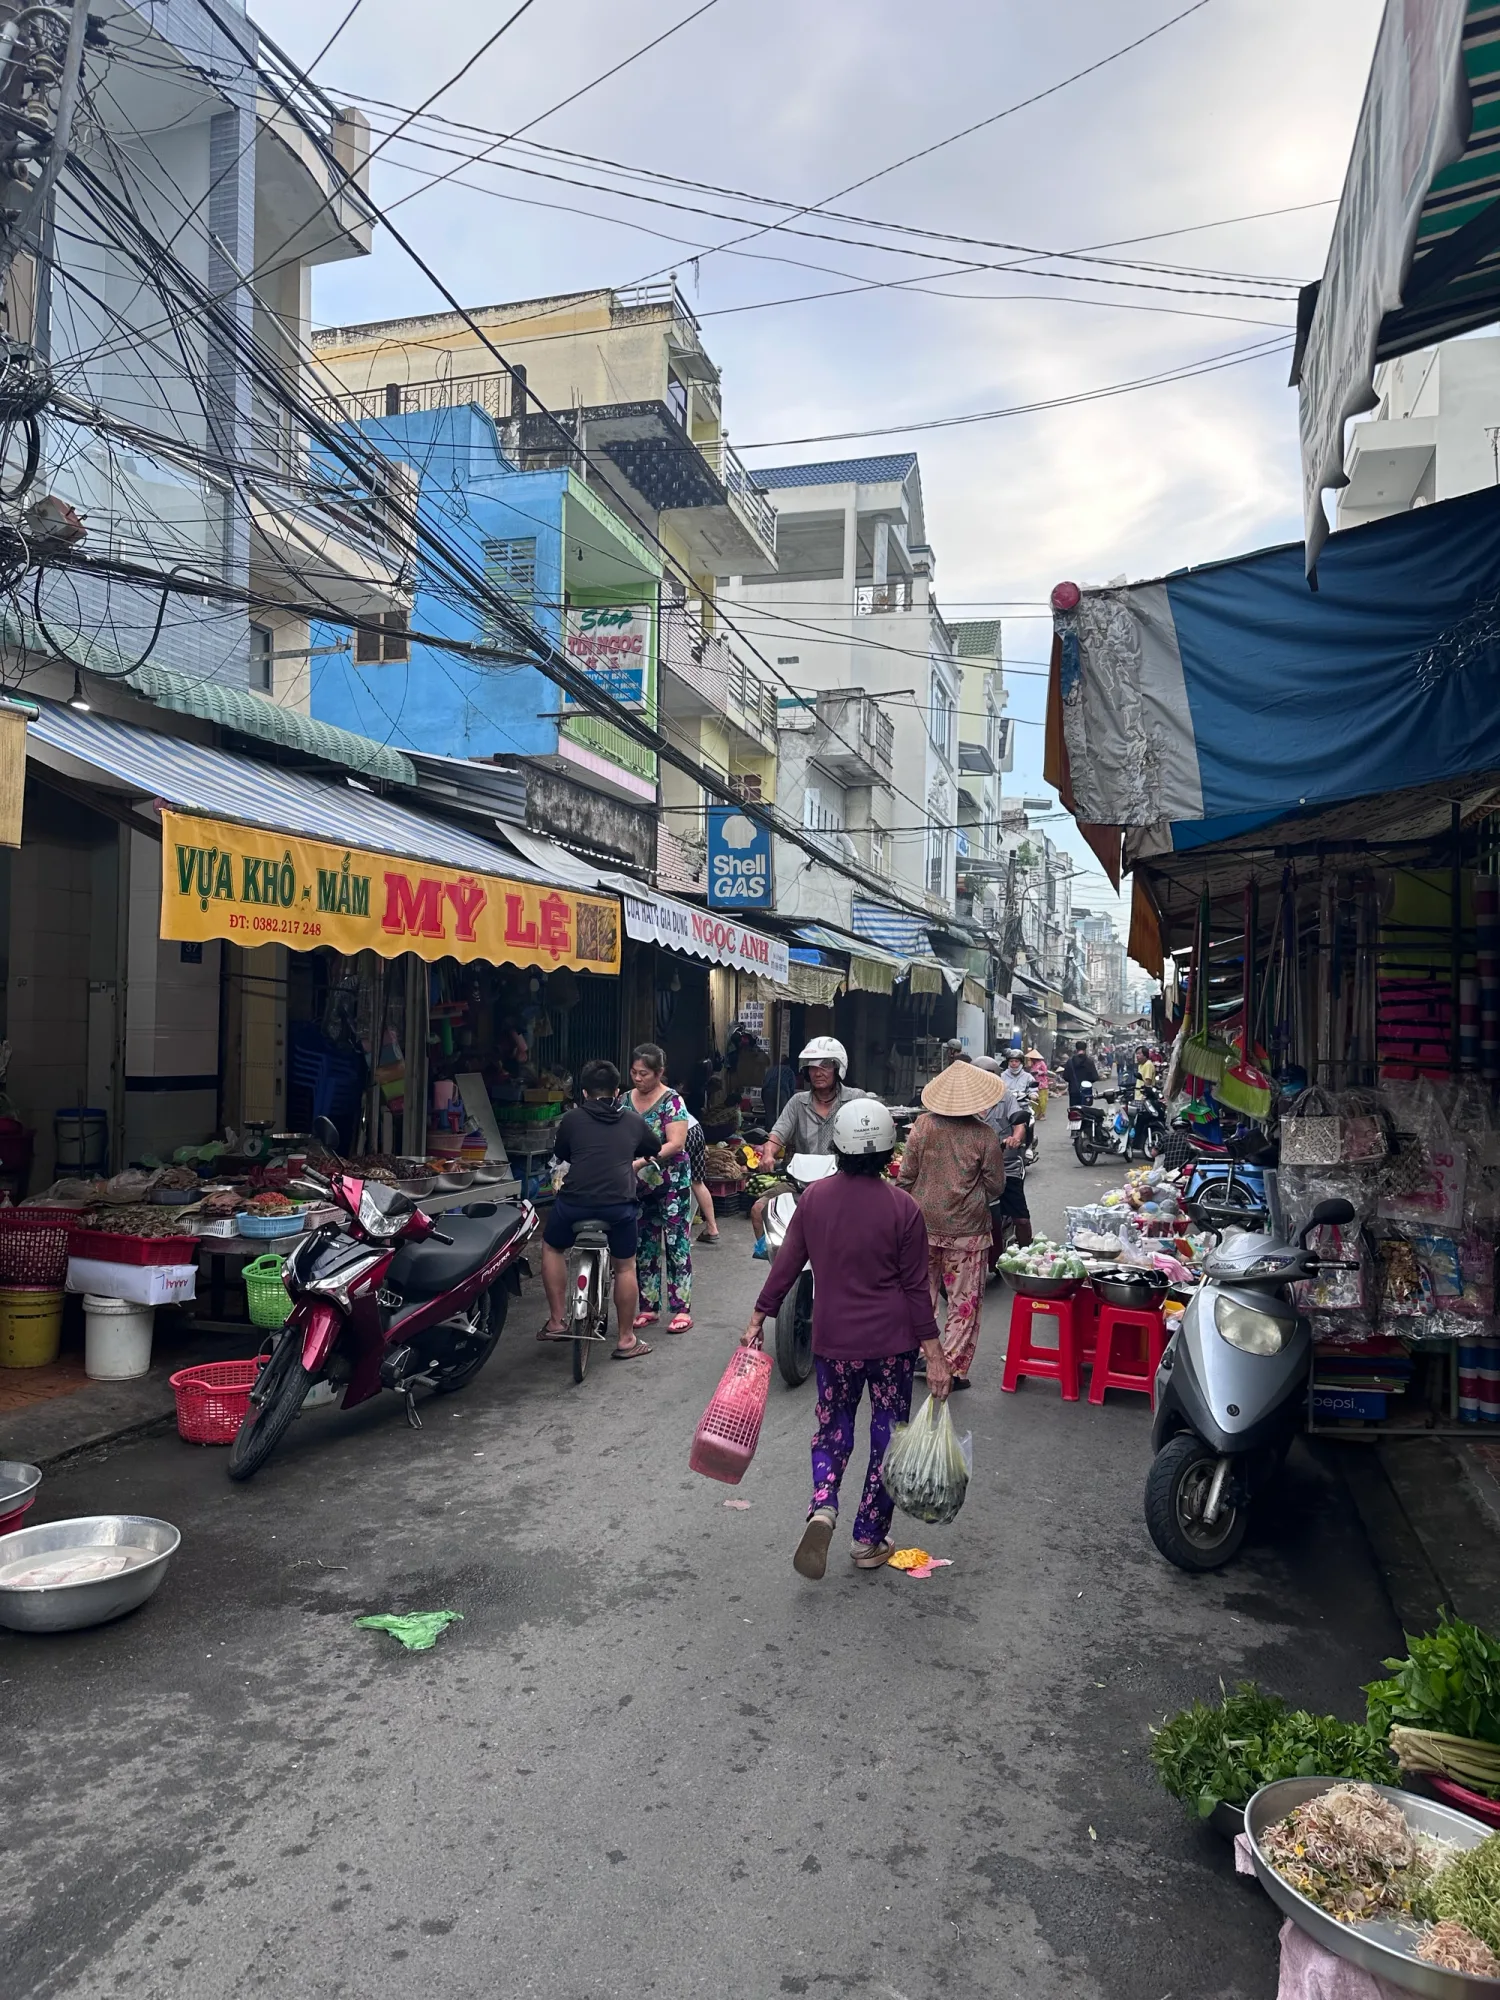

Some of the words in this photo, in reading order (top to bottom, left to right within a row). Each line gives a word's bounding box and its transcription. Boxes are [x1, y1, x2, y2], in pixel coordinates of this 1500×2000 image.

[580, 609, 634, 631] Shop
[597, 634, 643, 659] NGỌC
[713, 854, 766, 876] Shell
[175, 844, 235, 913] VỰA
[240, 850, 296, 909] KHÔ
[316, 851, 372, 918] MẮM
[714, 876, 766, 898] GAS
[229, 914, 250, 929] ĐT:
[252, 916, 300, 935] 0382.217
[302, 922, 322, 936] 248
[381, 871, 488, 942] MỸ
[504, 891, 571, 961] LỆ
[661, 907, 671, 931] GIA
[691, 913, 736, 957] NGỌC
[740, 933, 769, 965] ANH
